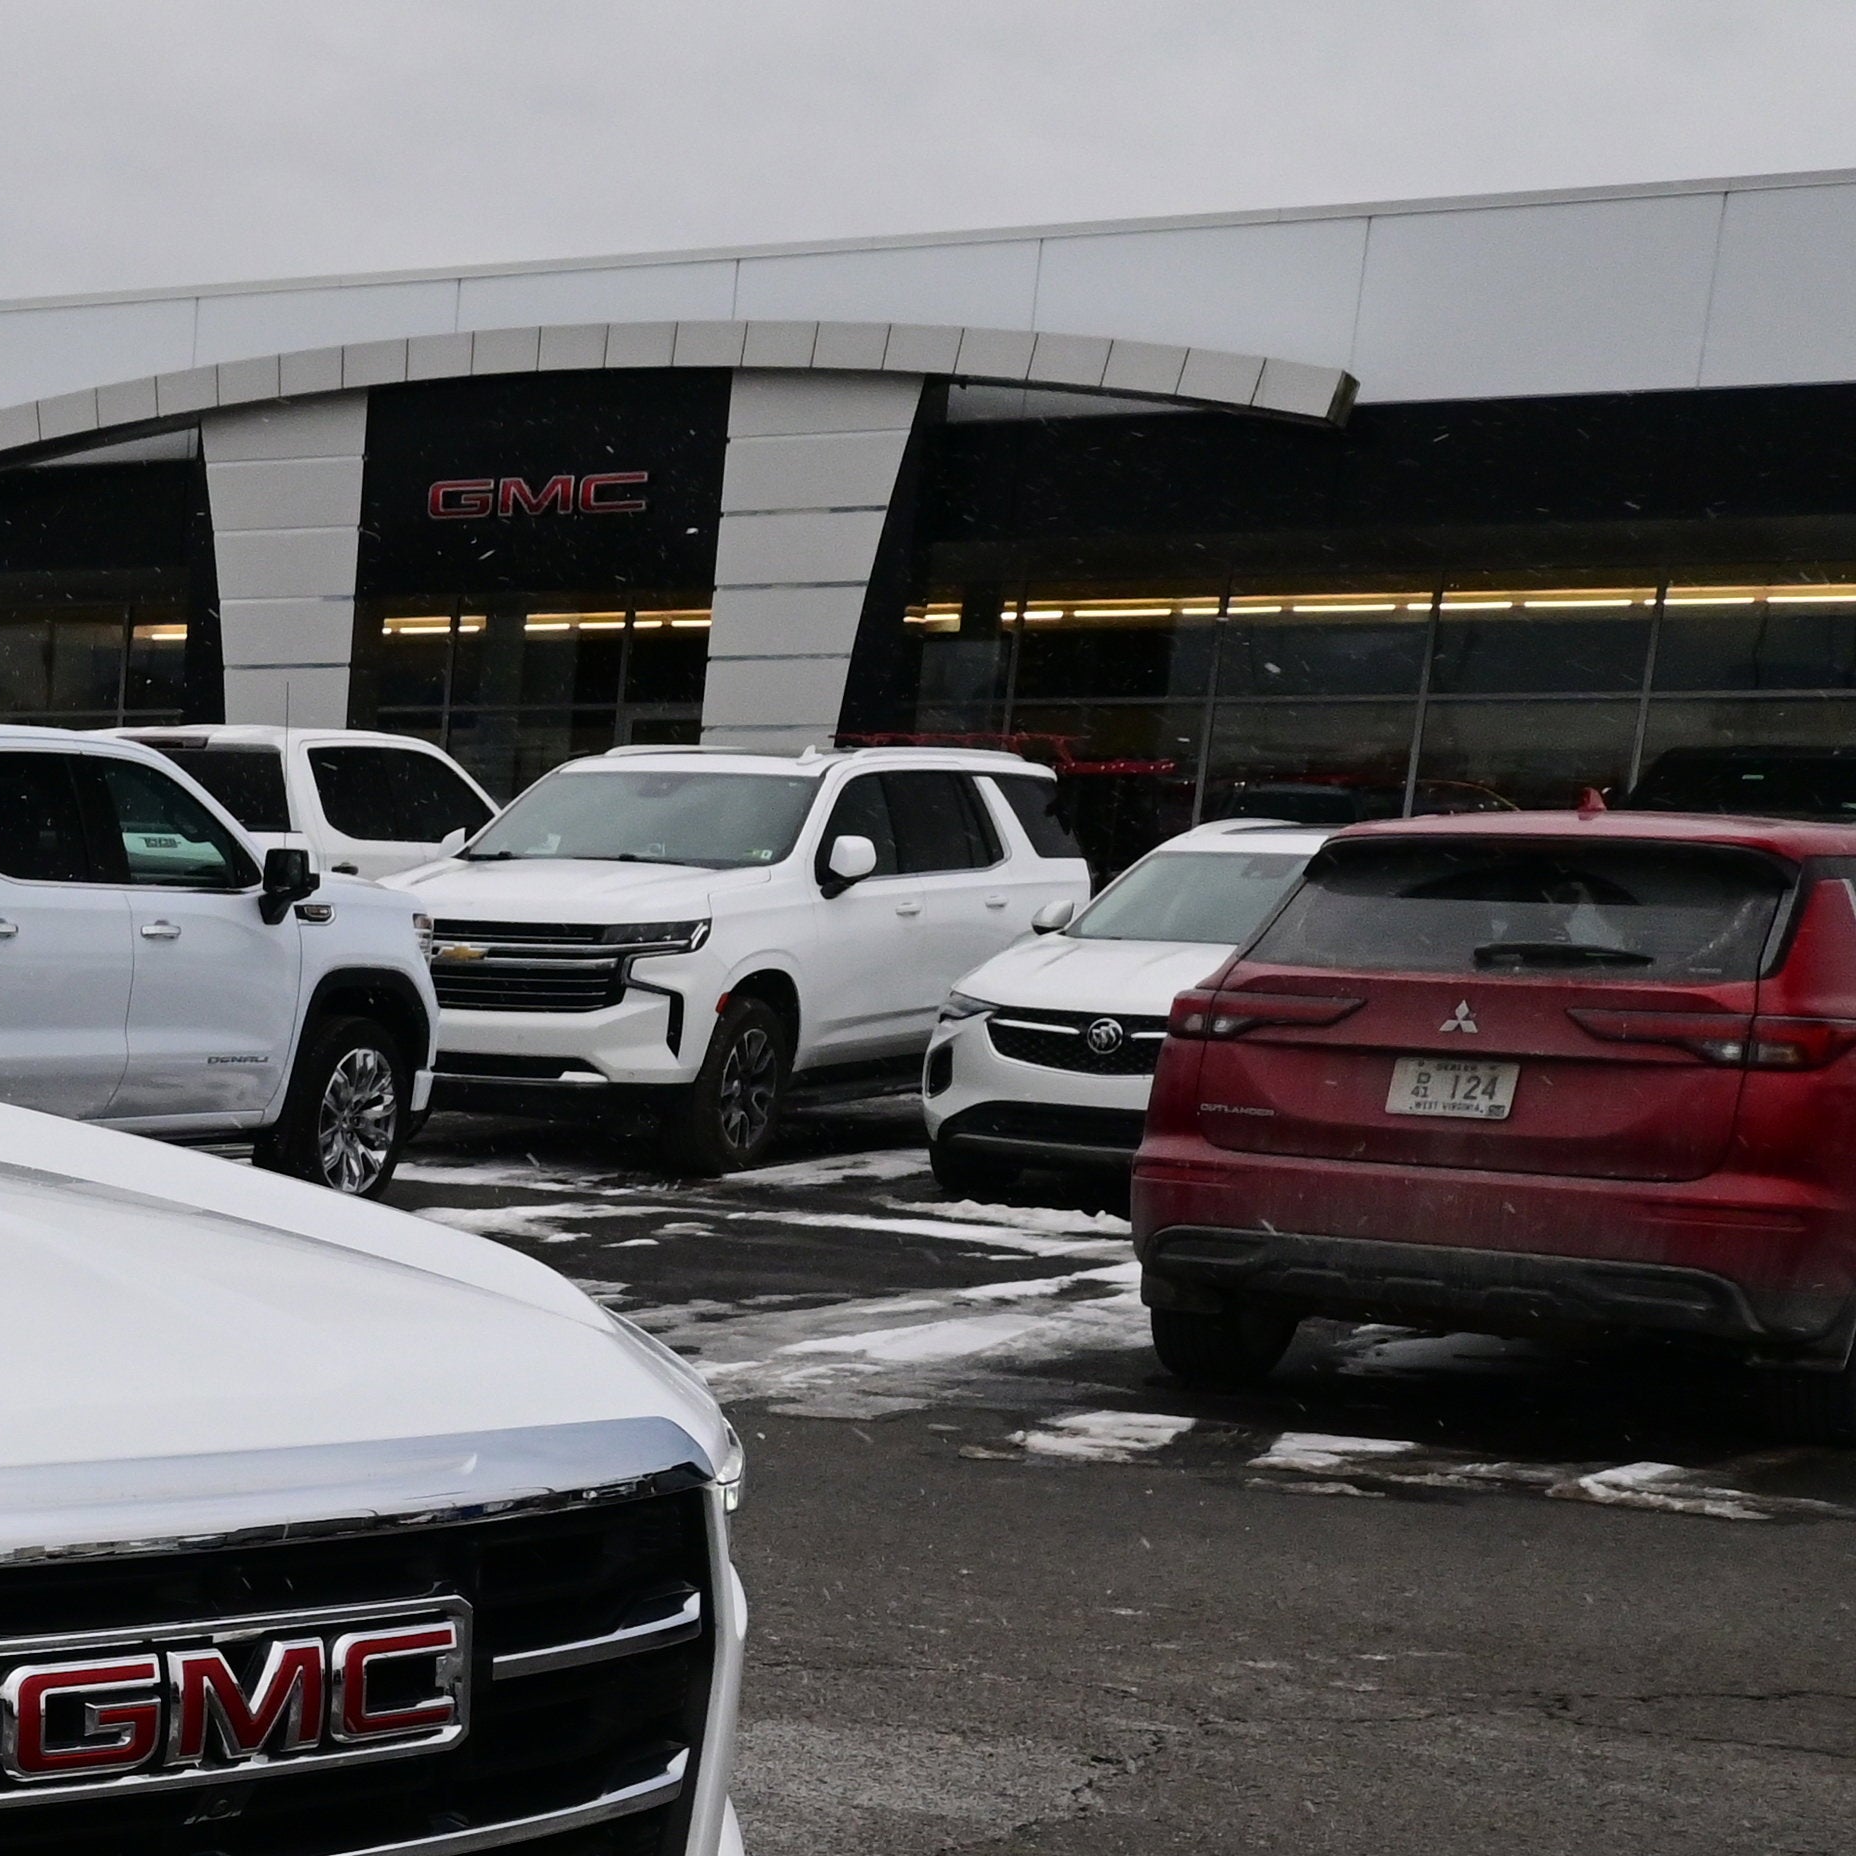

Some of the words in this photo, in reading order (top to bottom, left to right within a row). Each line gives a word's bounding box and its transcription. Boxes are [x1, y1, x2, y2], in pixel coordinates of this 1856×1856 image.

[427, 471, 649, 520] GMC
[1449, 1074, 1499, 1101] 124
[1199, 1103, 1275, 1117] OUTLANDER
